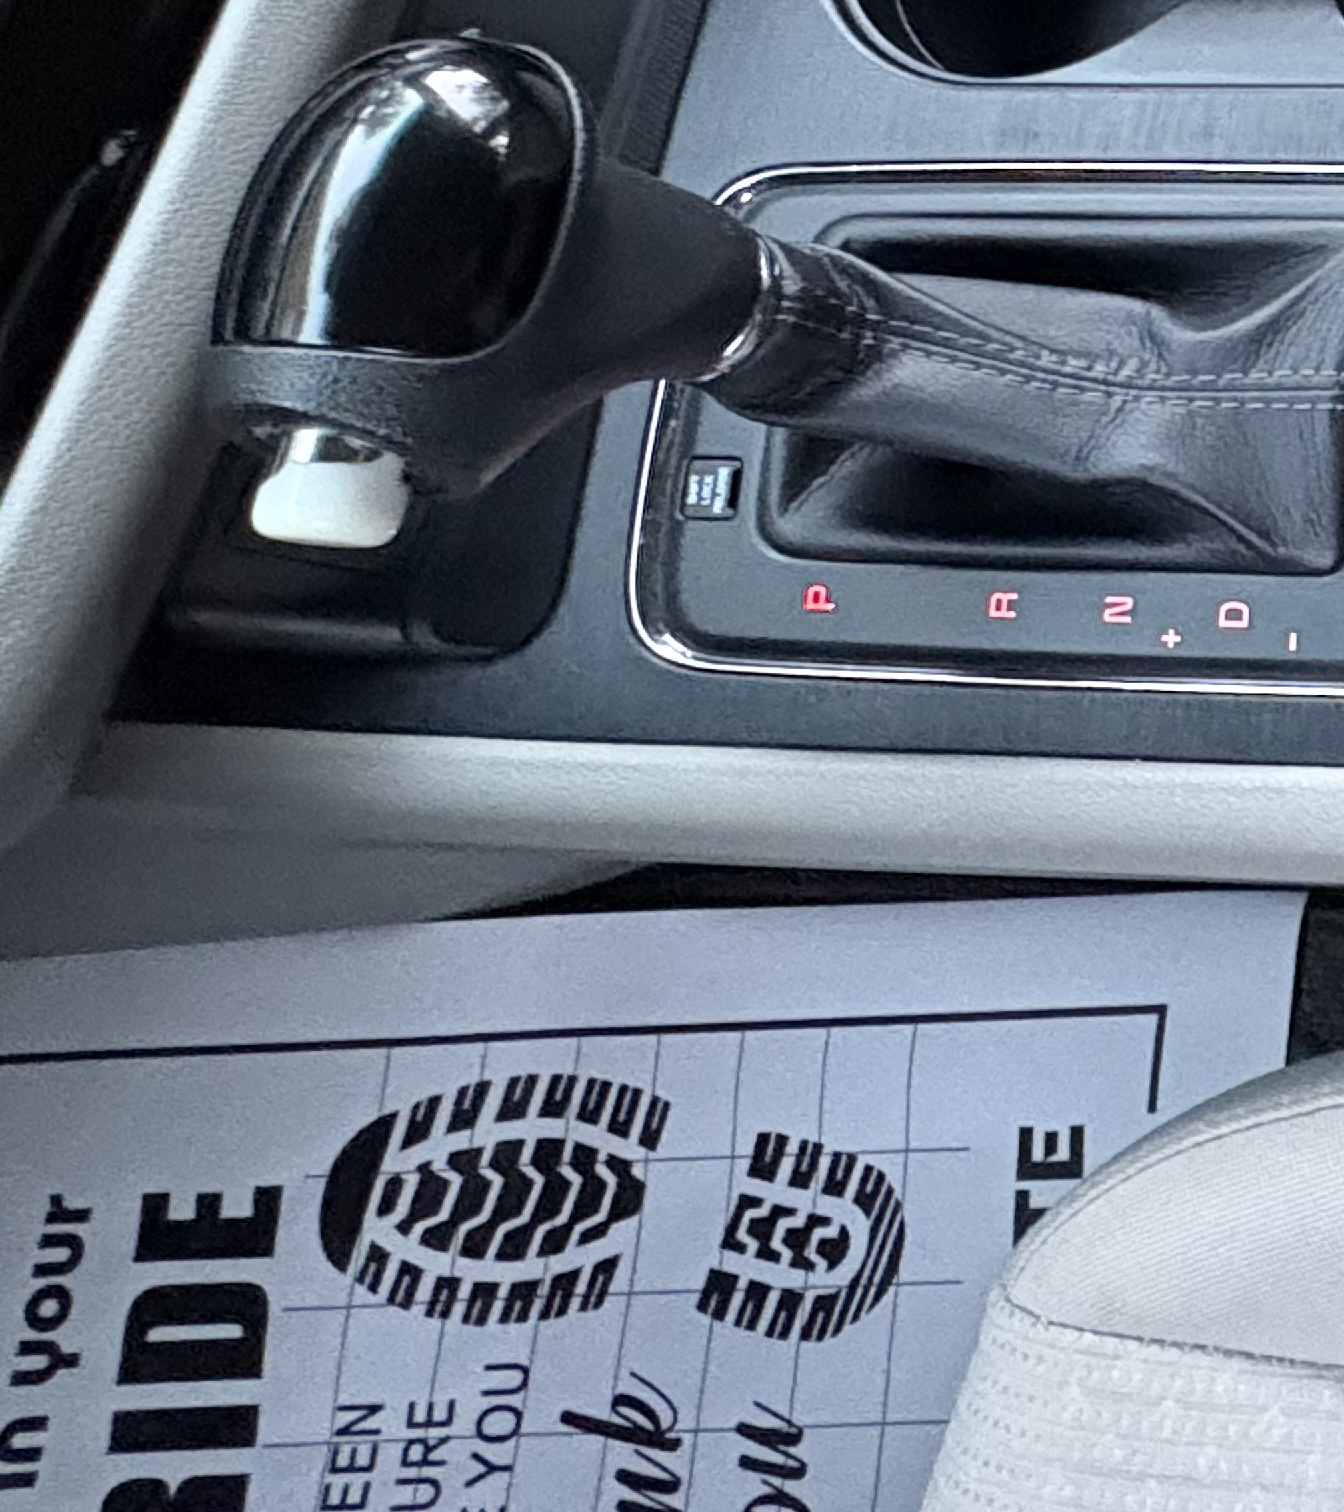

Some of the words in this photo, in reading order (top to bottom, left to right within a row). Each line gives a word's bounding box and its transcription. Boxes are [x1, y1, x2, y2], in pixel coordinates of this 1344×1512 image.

[803, 583, 835, 613] P
[988, 591, 1019, 618] R
[1102, 594, 1134, 624] N
[1217, 599, 1251, 629] D
[9, 1193, 92, 1386] your
[320, 1403, 384, 1512] EEN
[390, 1399, 456, 1512] URE
[464, 1363, 530, 1488] YOU
